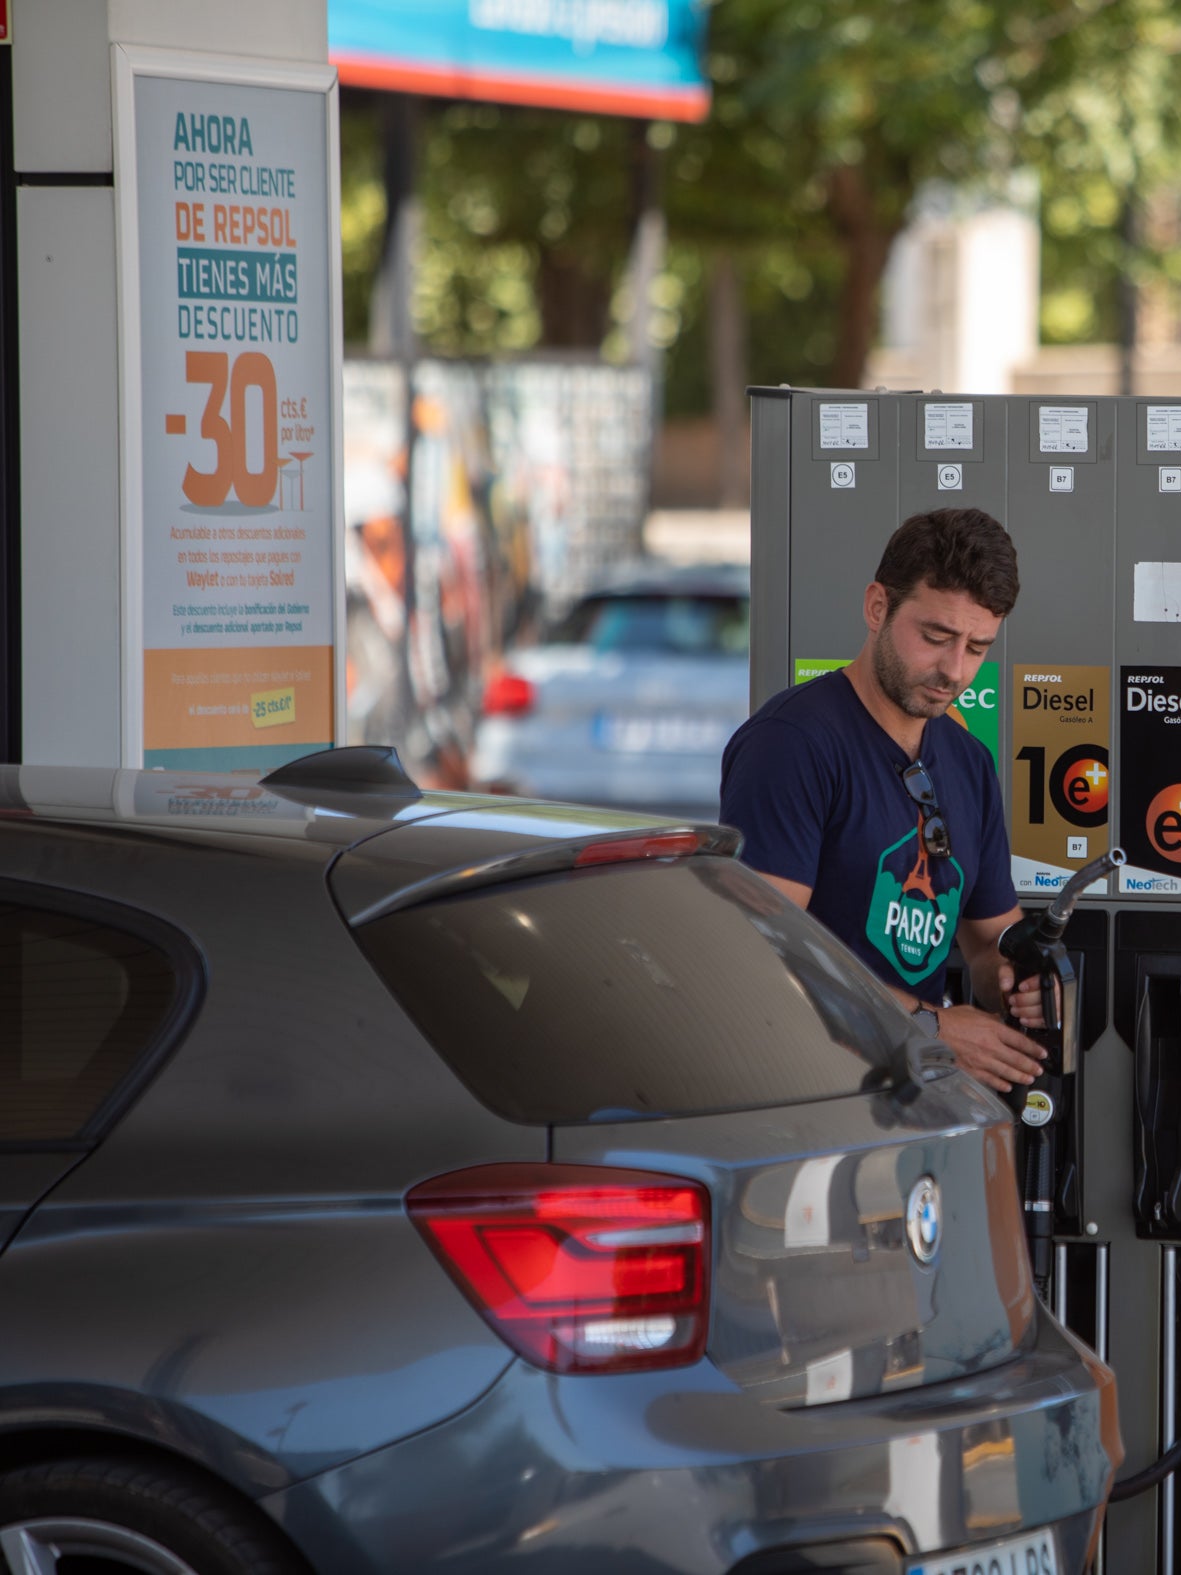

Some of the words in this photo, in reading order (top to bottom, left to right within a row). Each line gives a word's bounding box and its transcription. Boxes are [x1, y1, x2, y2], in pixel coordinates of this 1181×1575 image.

[174, 112, 253, 157] AHORA
[174, 161, 206, 193] POR
[208, 162, 238, 195] SER
[239, 165, 296, 199] CLIENTE
[175, 201, 206, 243] DE
[213, 203, 297, 249] REPSOL
[178, 257, 249, 296] TIENES
[256, 252, 296, 298] MÁS
[178, 304, 299, 344] DESCUENTO
[165, 350, 278, 508] -30
[837, 471, 849, 480] E5
[944, 473, 956, 481] E5
[1056, 475, 1068, 484] B7
[1166, 476, 1178, 485] B7
[187, 569, 219, 590] Waylet
[1023, 674, 1063, 683] REPSOL
[1127, 676, 1165, 684] REPSOL
[1023, 686, 1094, 712] Diesel
[1059, 715, 1087, 724] Gasóleo
[1088, 716, 1094, 724] A
[1015, 743, 1109, 829] 10
[1072, 843, 1082, 851] B7
[1019, 878, 1032, 887] con
[884, 901, 947, 948] PARIS
[901, 943, 921, 957] TENNIS
